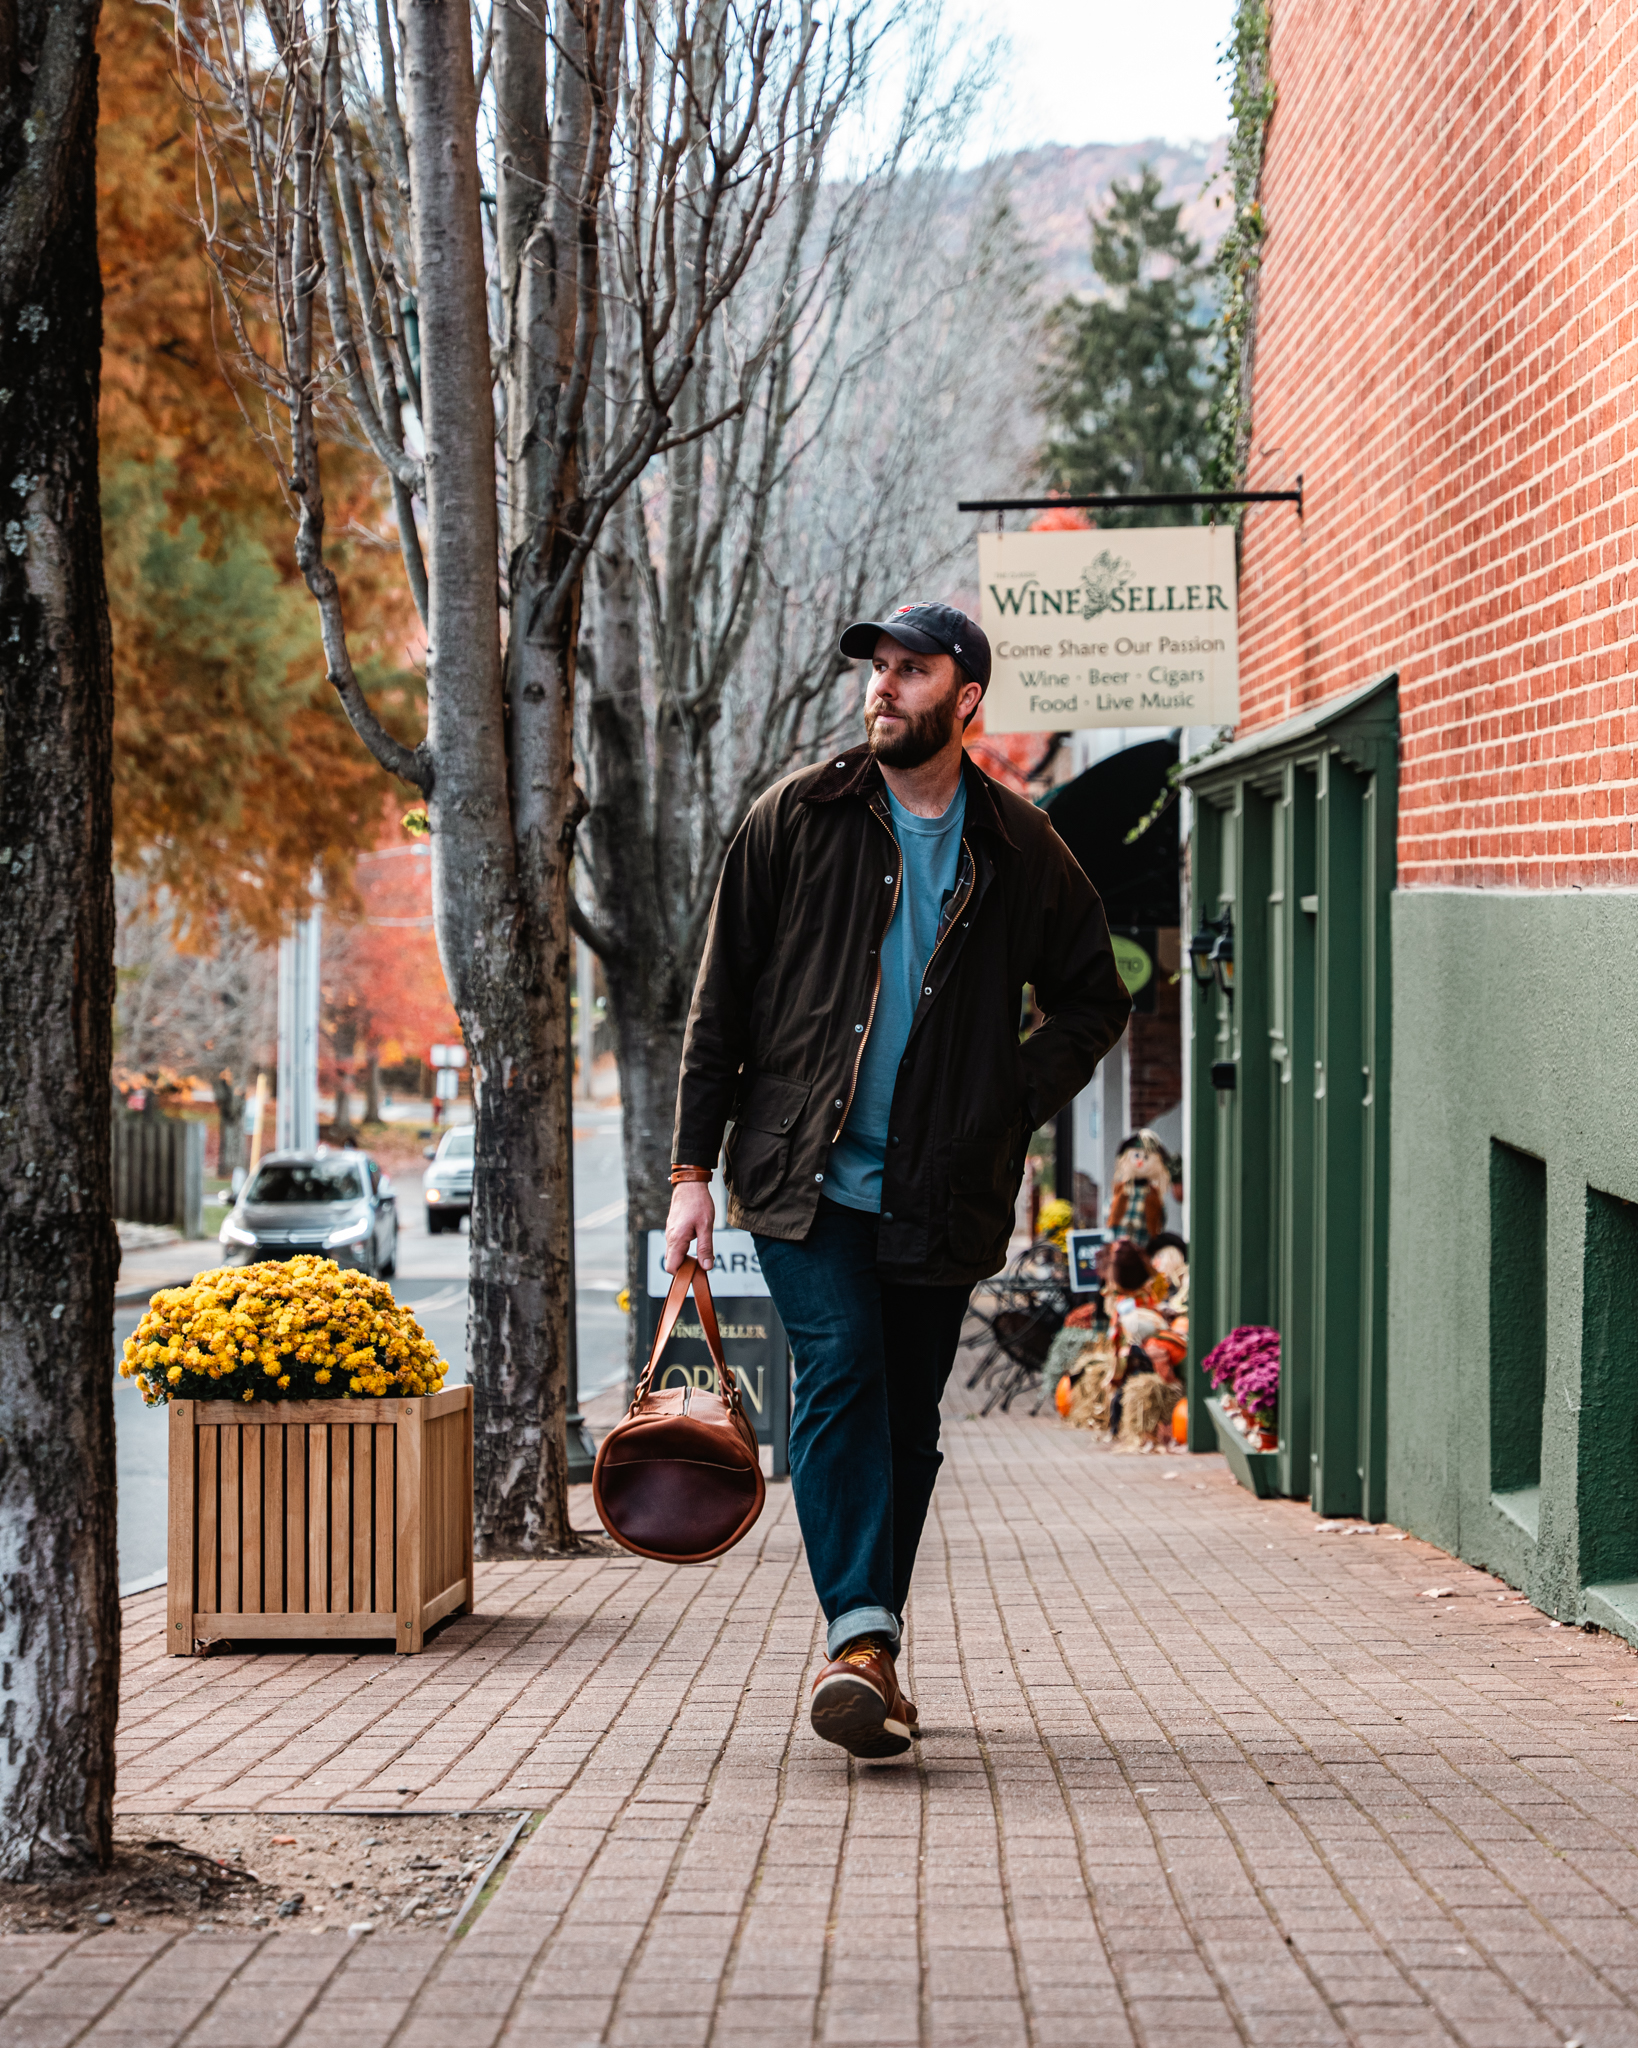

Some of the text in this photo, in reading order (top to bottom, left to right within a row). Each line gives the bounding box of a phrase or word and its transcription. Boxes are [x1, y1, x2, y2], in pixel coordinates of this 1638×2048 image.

[989, 579, 1230, 616] WINE SELLER
[995, 635, 1226, 660] Come Share Our Passion
[1020, 665, 1205, 687] Wine Beer Cigars
[1030, 691, 1195, 712] Food Live Music
